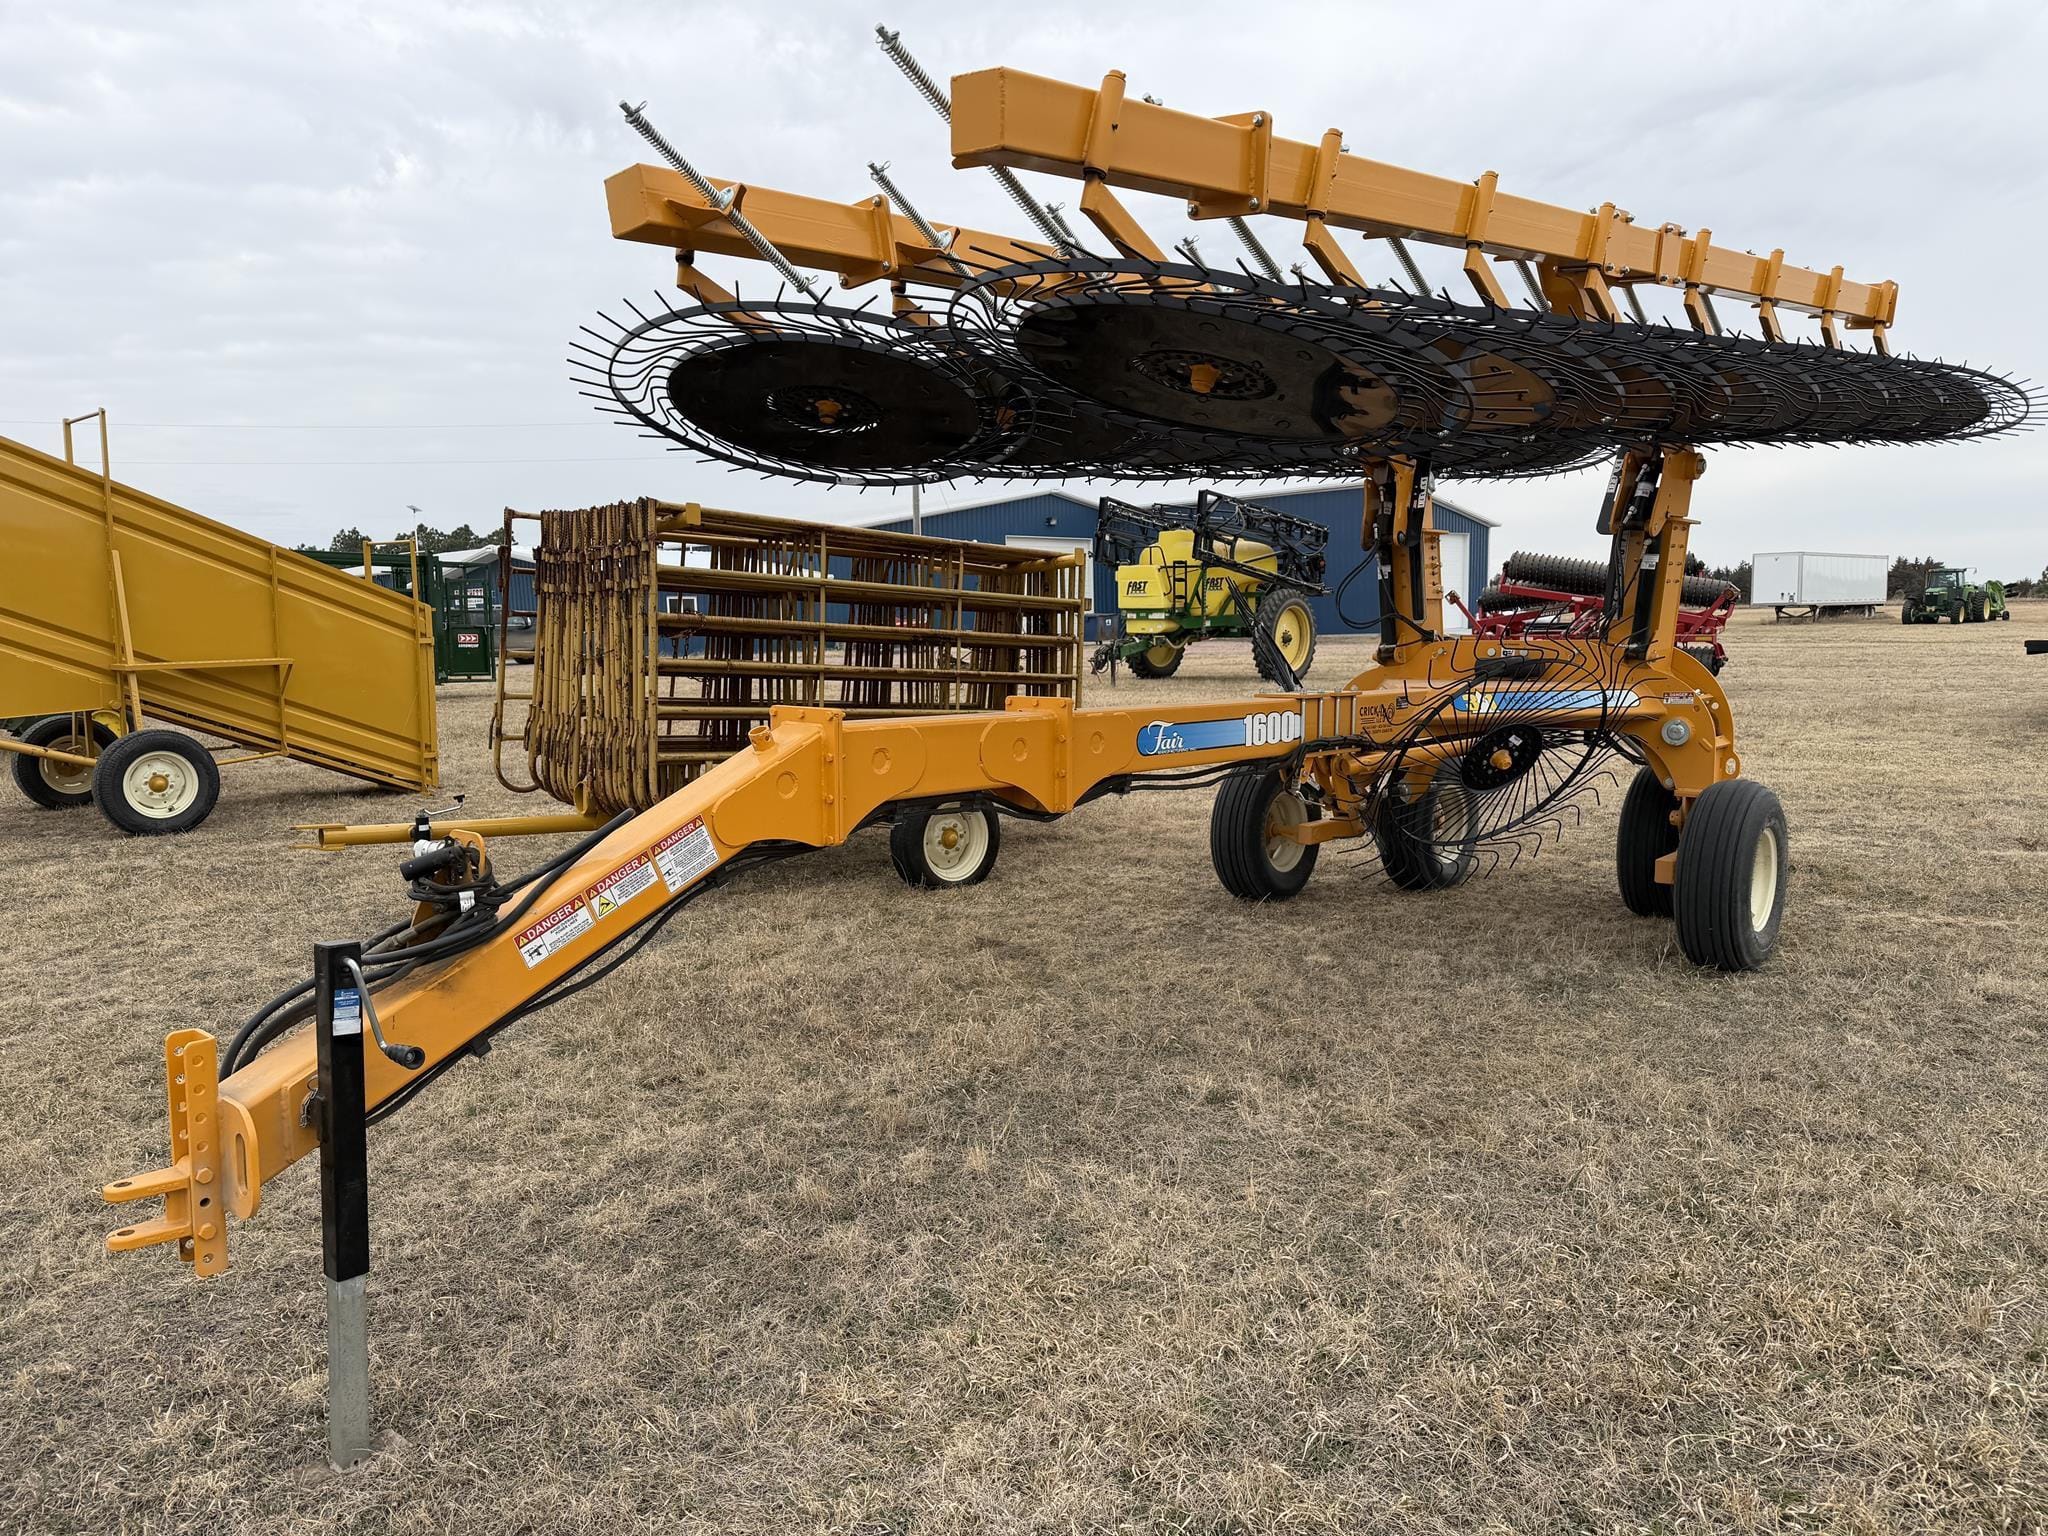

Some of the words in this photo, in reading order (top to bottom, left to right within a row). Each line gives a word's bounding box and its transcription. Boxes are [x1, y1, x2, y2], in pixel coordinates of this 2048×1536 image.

[1127, 580, 1149, 596] FAST
[1146, 720, 1185, 755] Fair
[660, 823, 696, 850] DANGER
[597, 859, 641, 892] DANGER
[526, 904, 574, 940] DANGER
